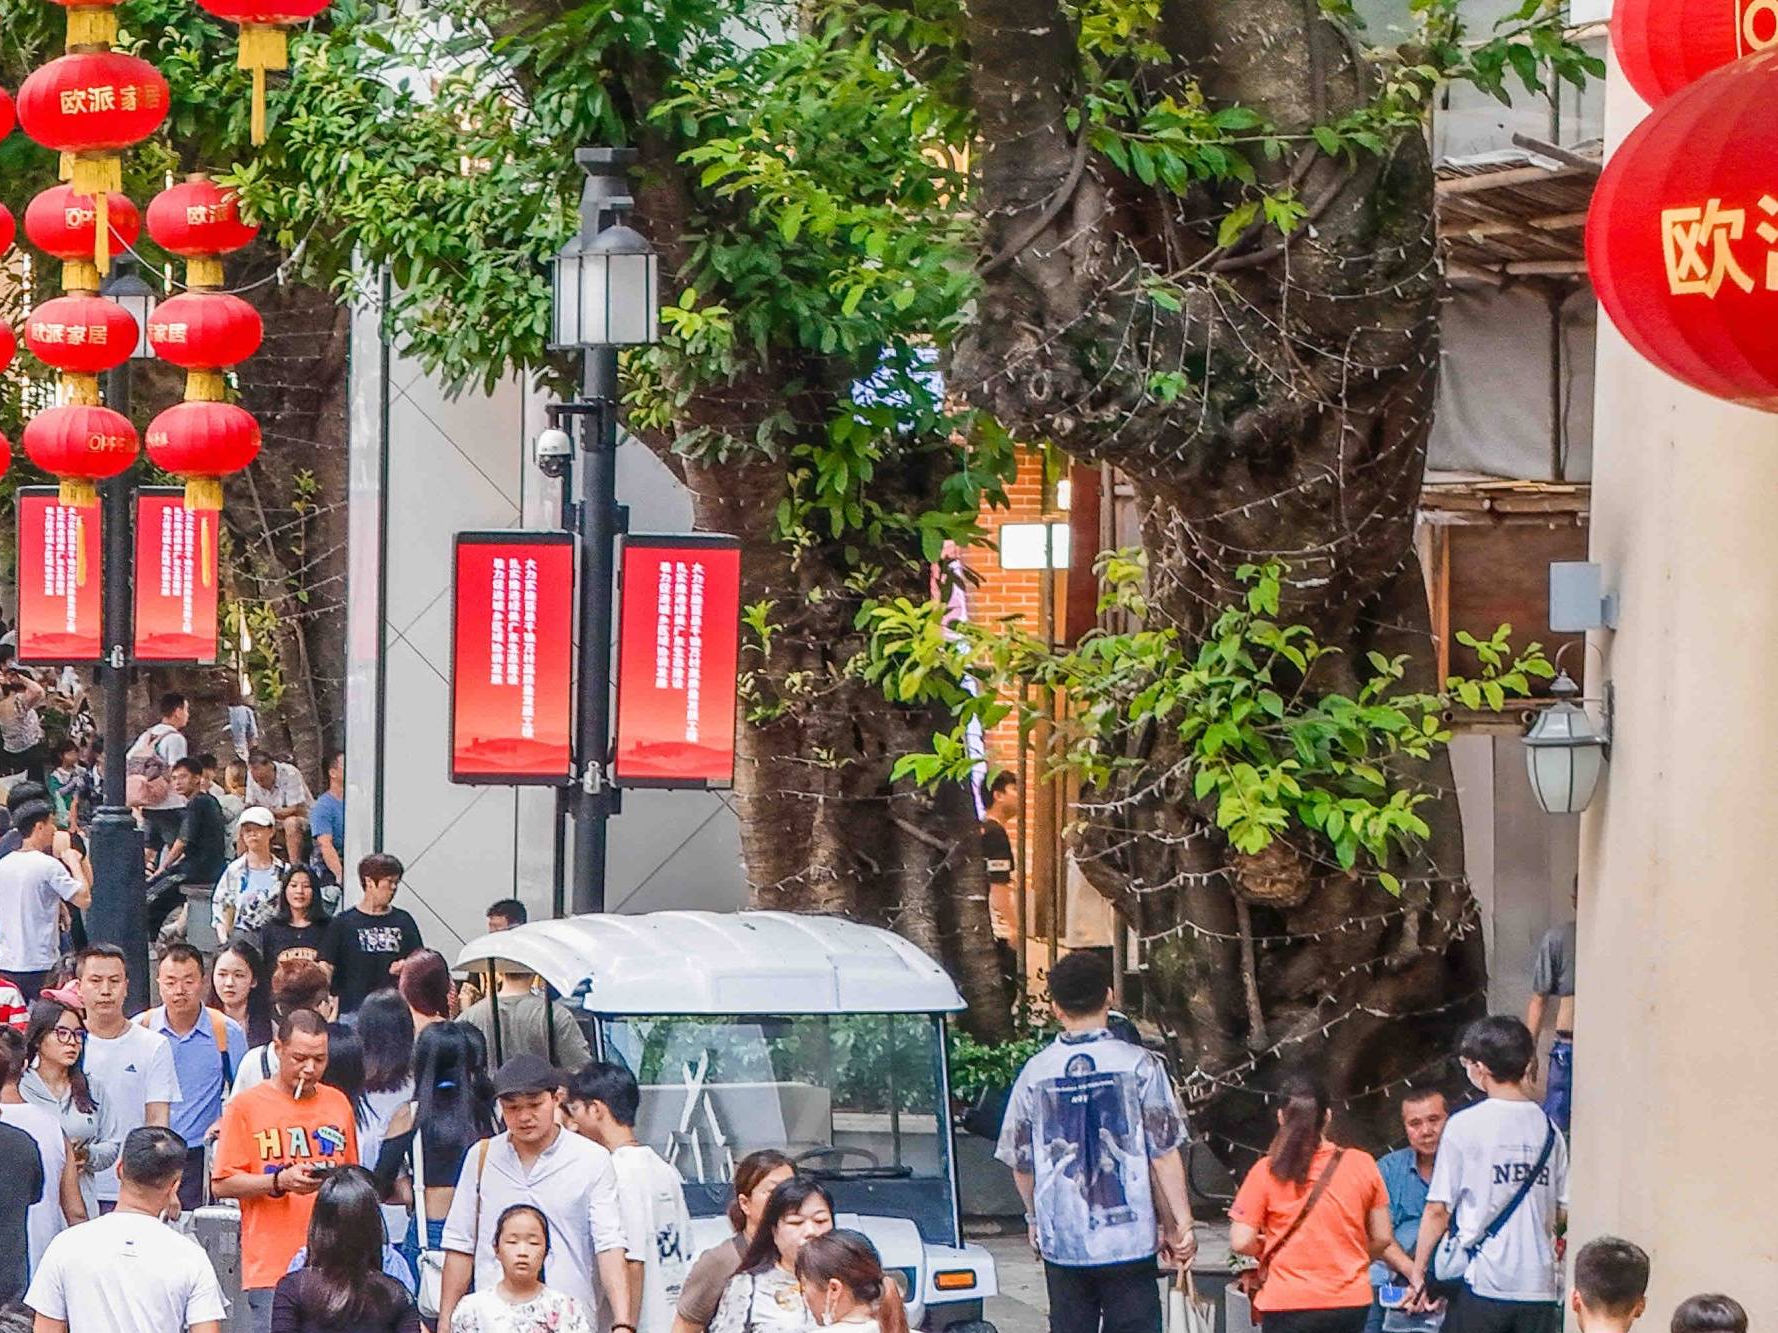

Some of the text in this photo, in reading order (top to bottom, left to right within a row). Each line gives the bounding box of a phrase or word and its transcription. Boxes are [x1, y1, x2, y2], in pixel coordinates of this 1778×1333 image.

[59, 84, 161, 115] 欧派家居
[31, 321, 108, 346] 欧派家居
